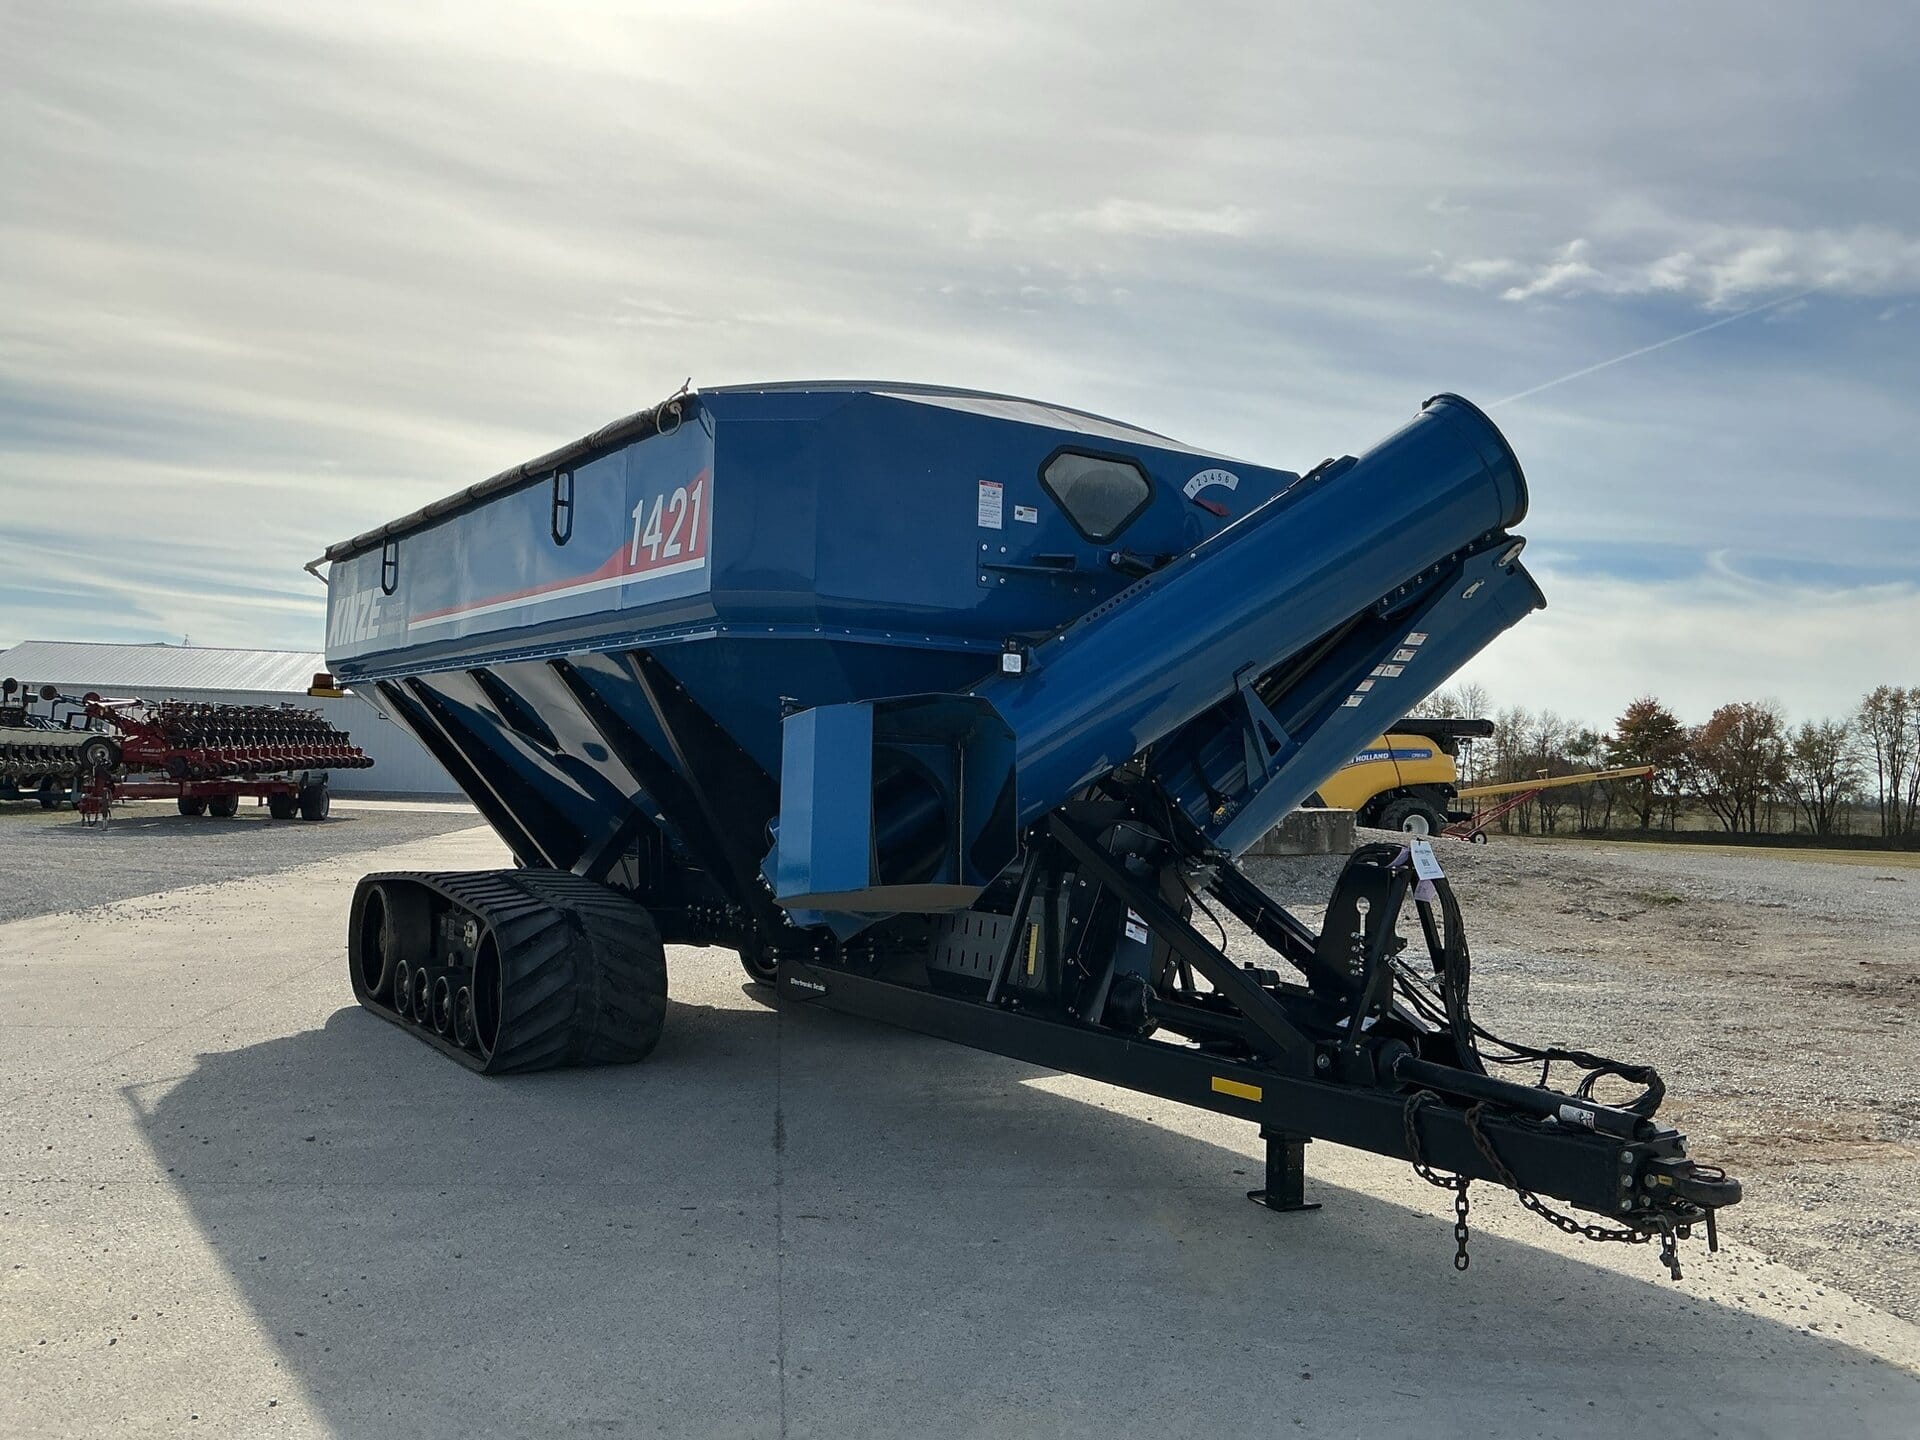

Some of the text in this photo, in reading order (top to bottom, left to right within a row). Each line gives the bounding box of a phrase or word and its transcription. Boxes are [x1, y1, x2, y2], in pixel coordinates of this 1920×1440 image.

[1196, 478, 1201, 486] 2
[1203, 474, 1208, 483] 3
[1210, 473, 1215, 481] 4
[1217, 473, 1222, 482] 5
[630, 480, 703, 566] 1421
[327, 586, 386, 648] KINZE
[1355, 752, 1389, 763] HOLLAND
